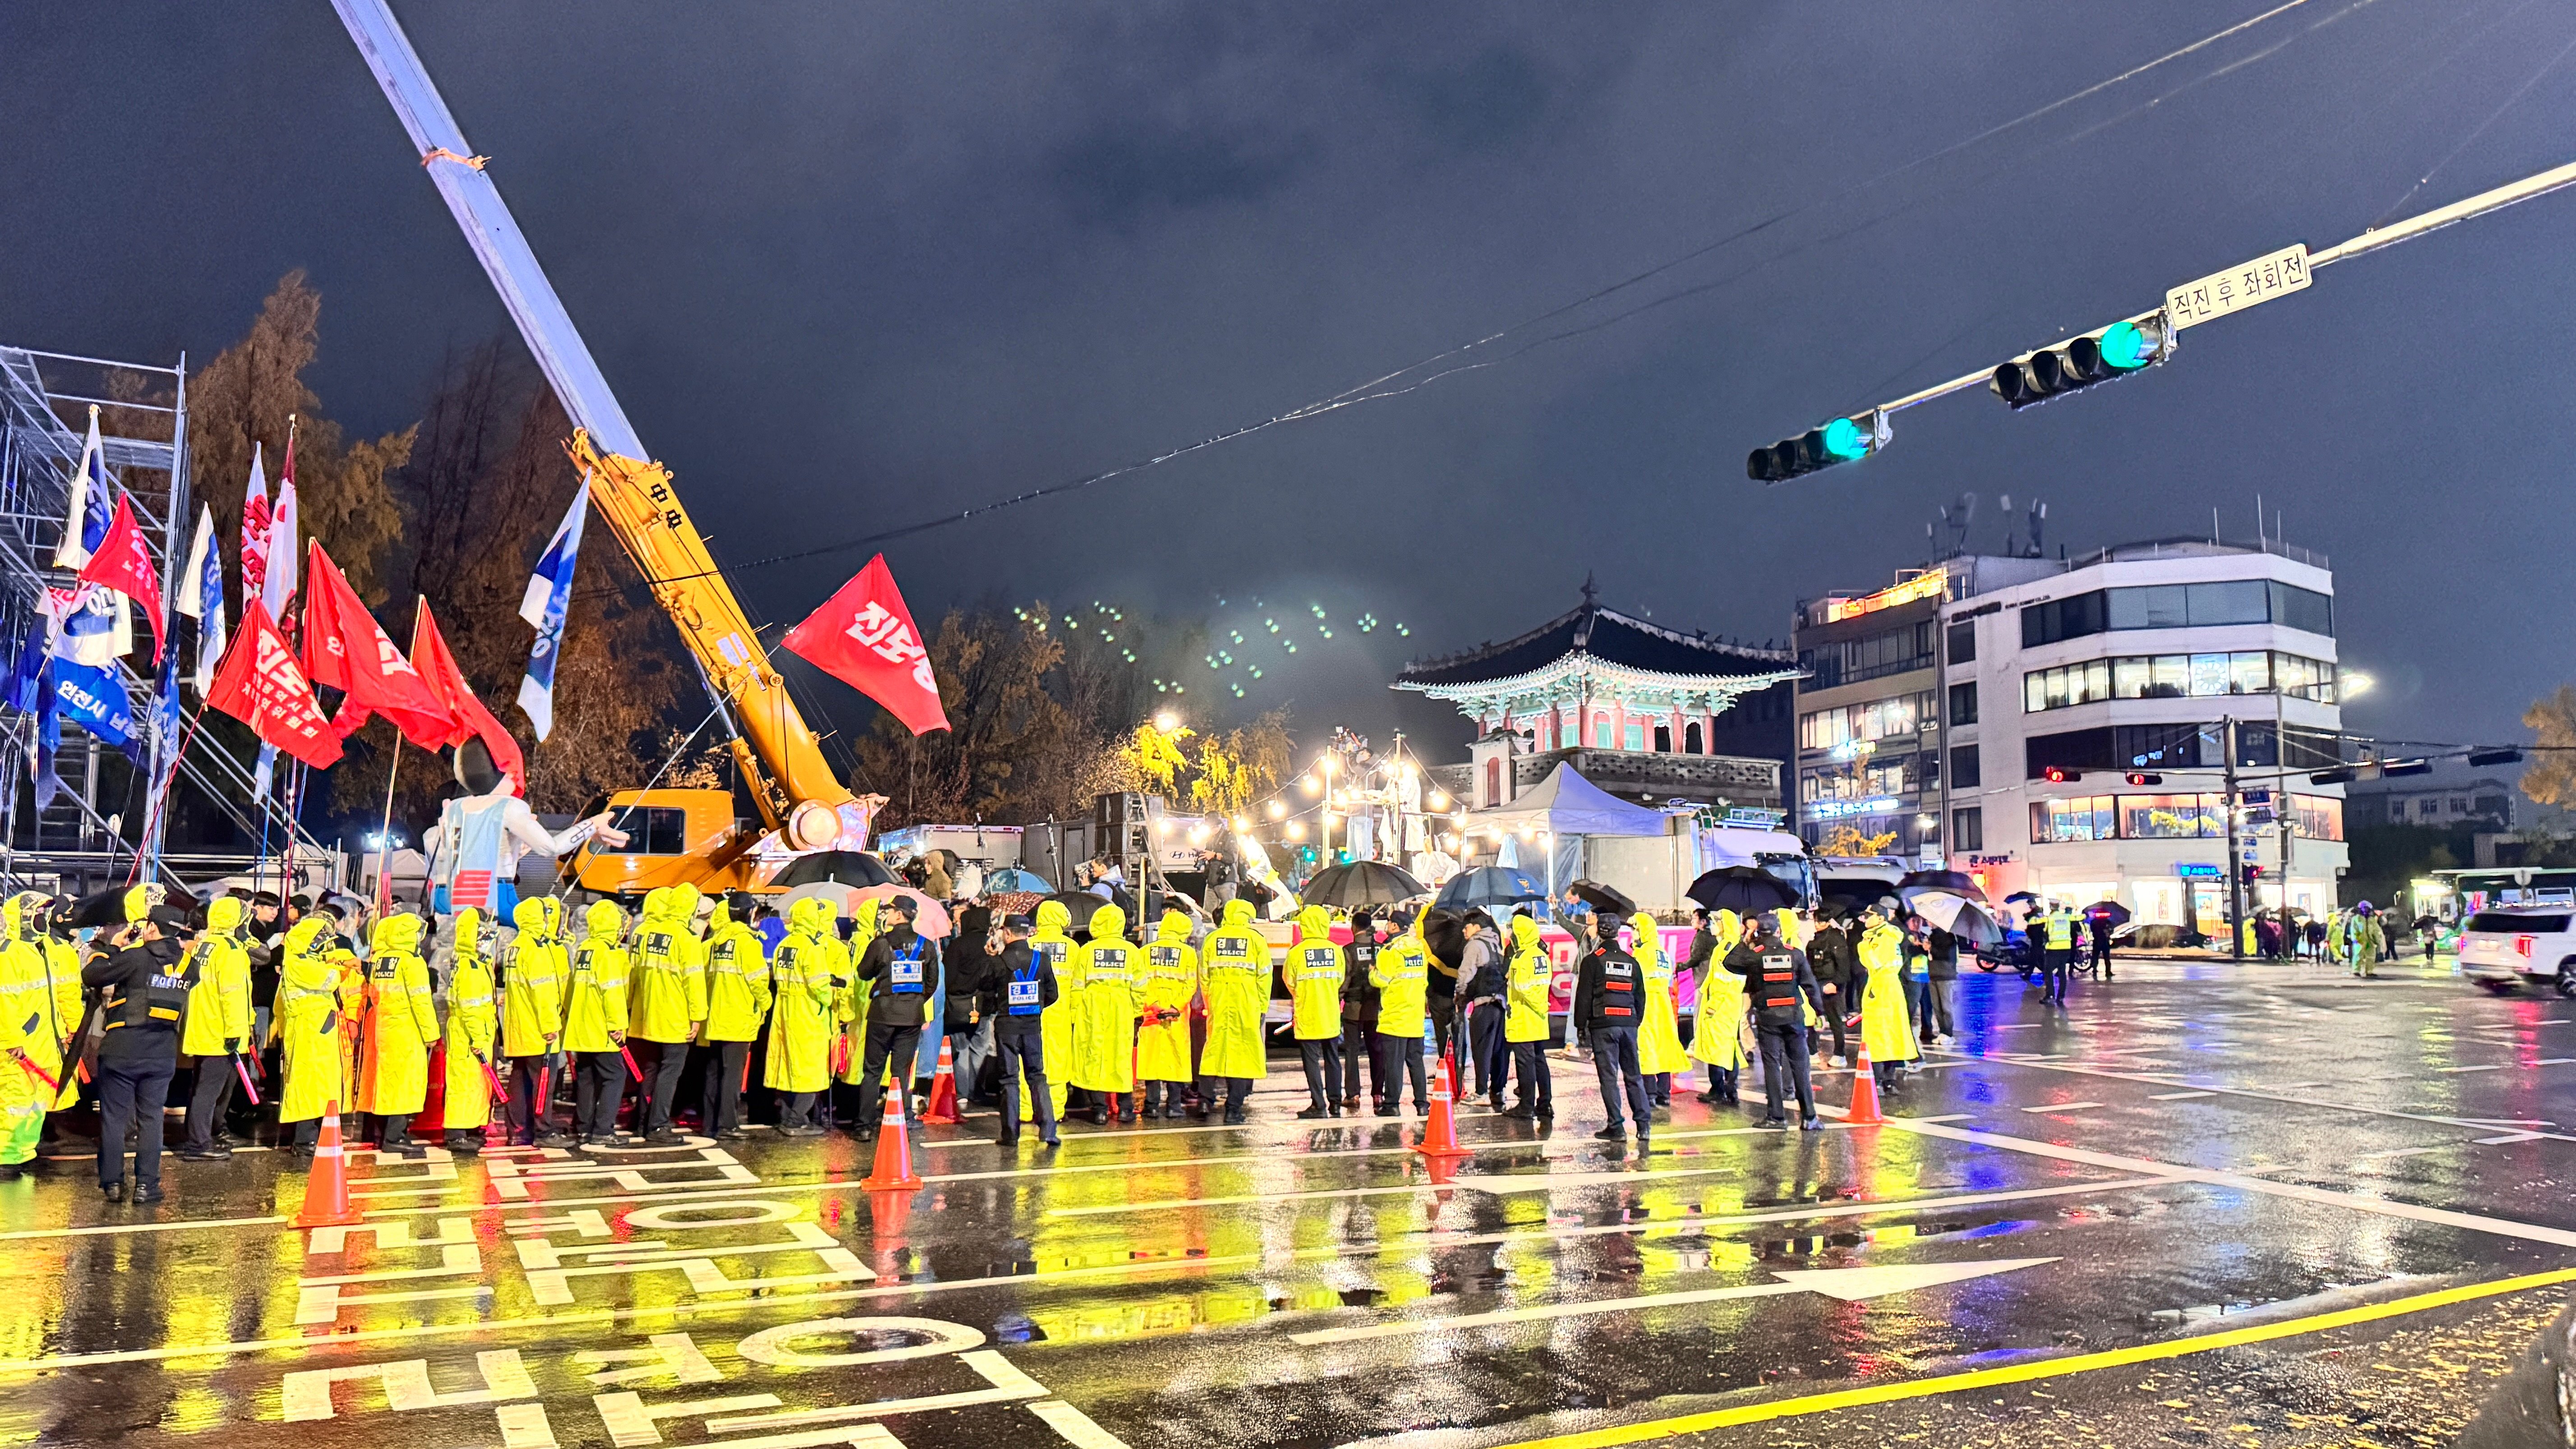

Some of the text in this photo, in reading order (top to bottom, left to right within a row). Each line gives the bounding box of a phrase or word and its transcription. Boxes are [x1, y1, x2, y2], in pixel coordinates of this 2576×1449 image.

[2174, 253, 2304, 320] 직진 후 좌회전
[253, 673, 316, 721] 광역시당
[241, 682, 318, 739] 역위원회
[1217, 938, 1247, 949] 경찰
[1095, 949, 1125, 961] 경찰
[1151, 947, 1180, 959] 경찰
[1306, 949, 1334, 960] 경찰
[151, 974, 189, 989] POLICE
[1011, 984, 1036, 995] 경찰
